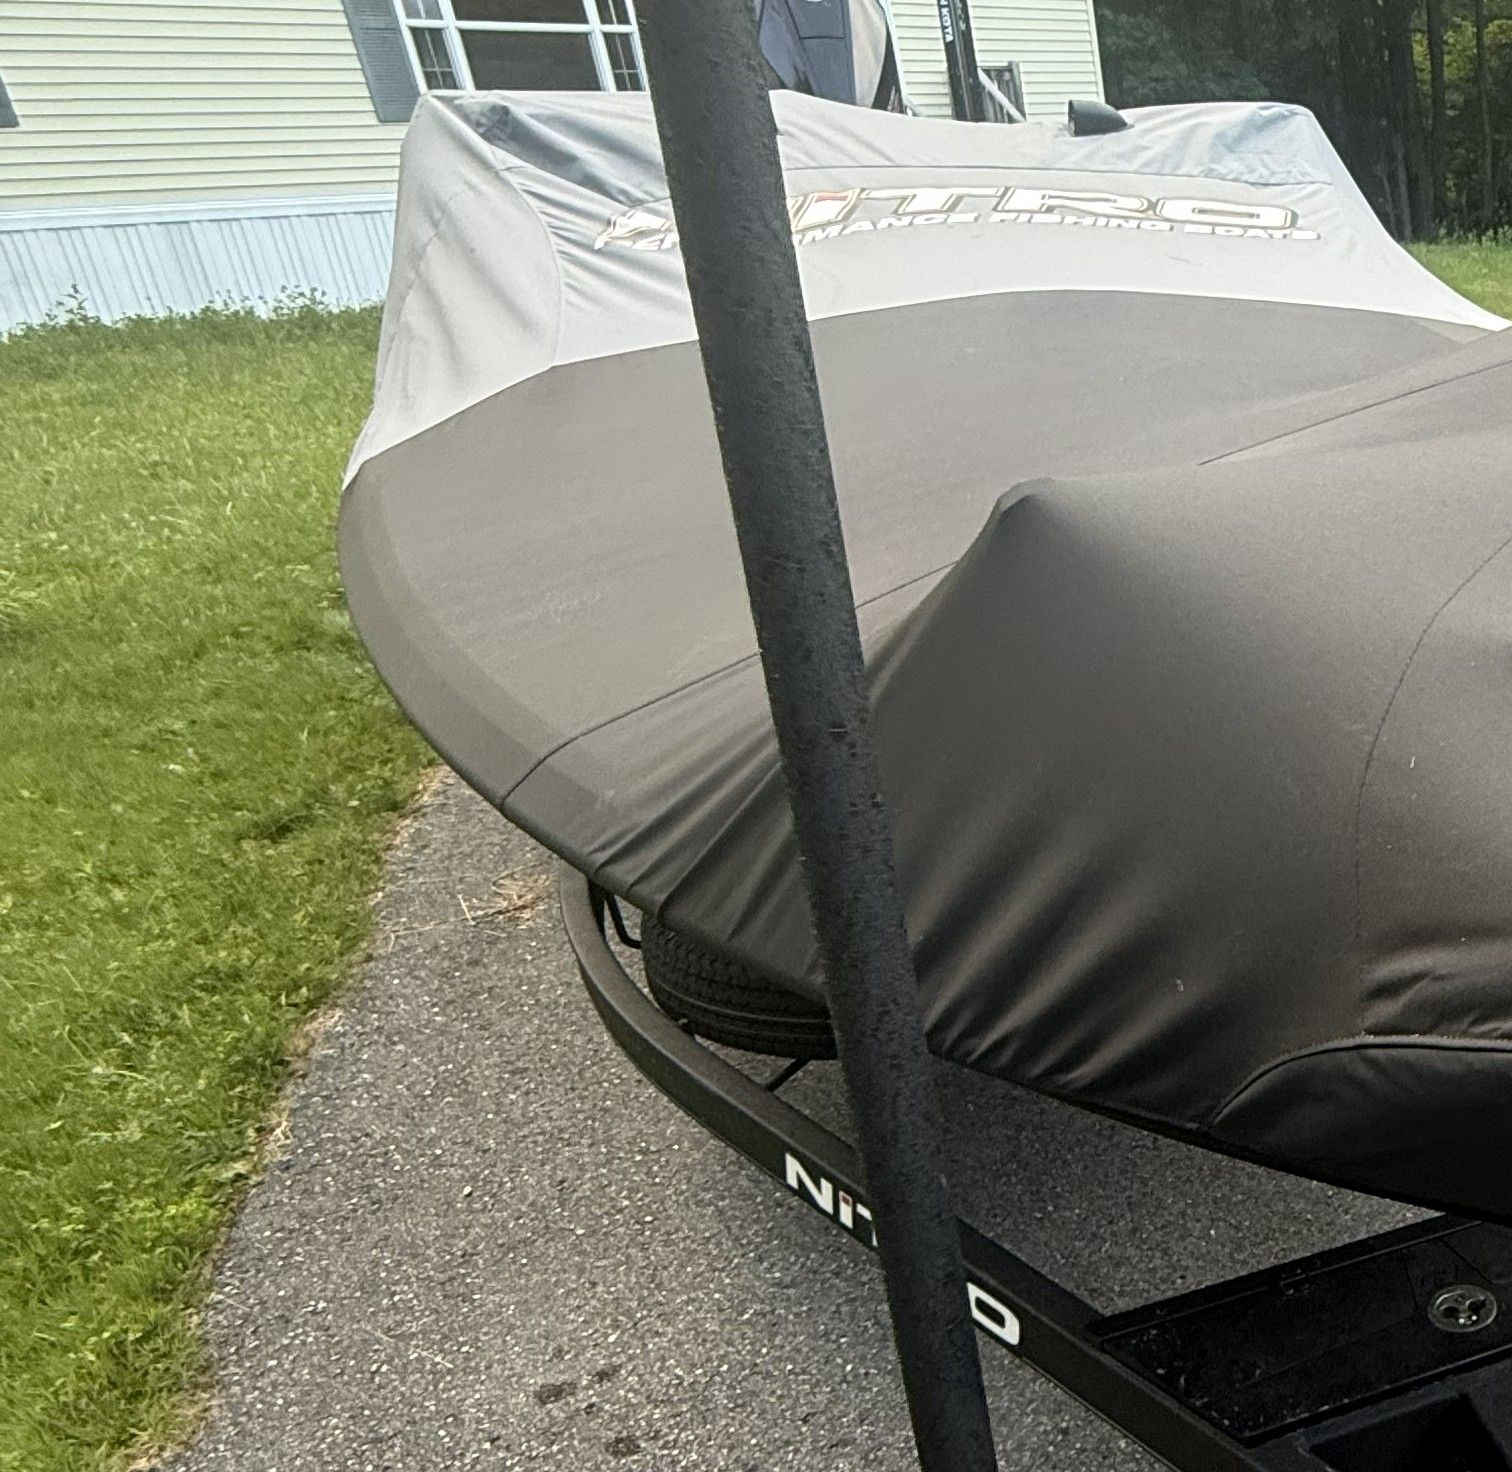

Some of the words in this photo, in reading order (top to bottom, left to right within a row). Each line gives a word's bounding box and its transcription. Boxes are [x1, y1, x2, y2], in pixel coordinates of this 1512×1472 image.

[940, 7, 954, 43] KOTA
[988, 212, 1175, 232] FISHING
[1184, 223, 1322, 241] BOATS
